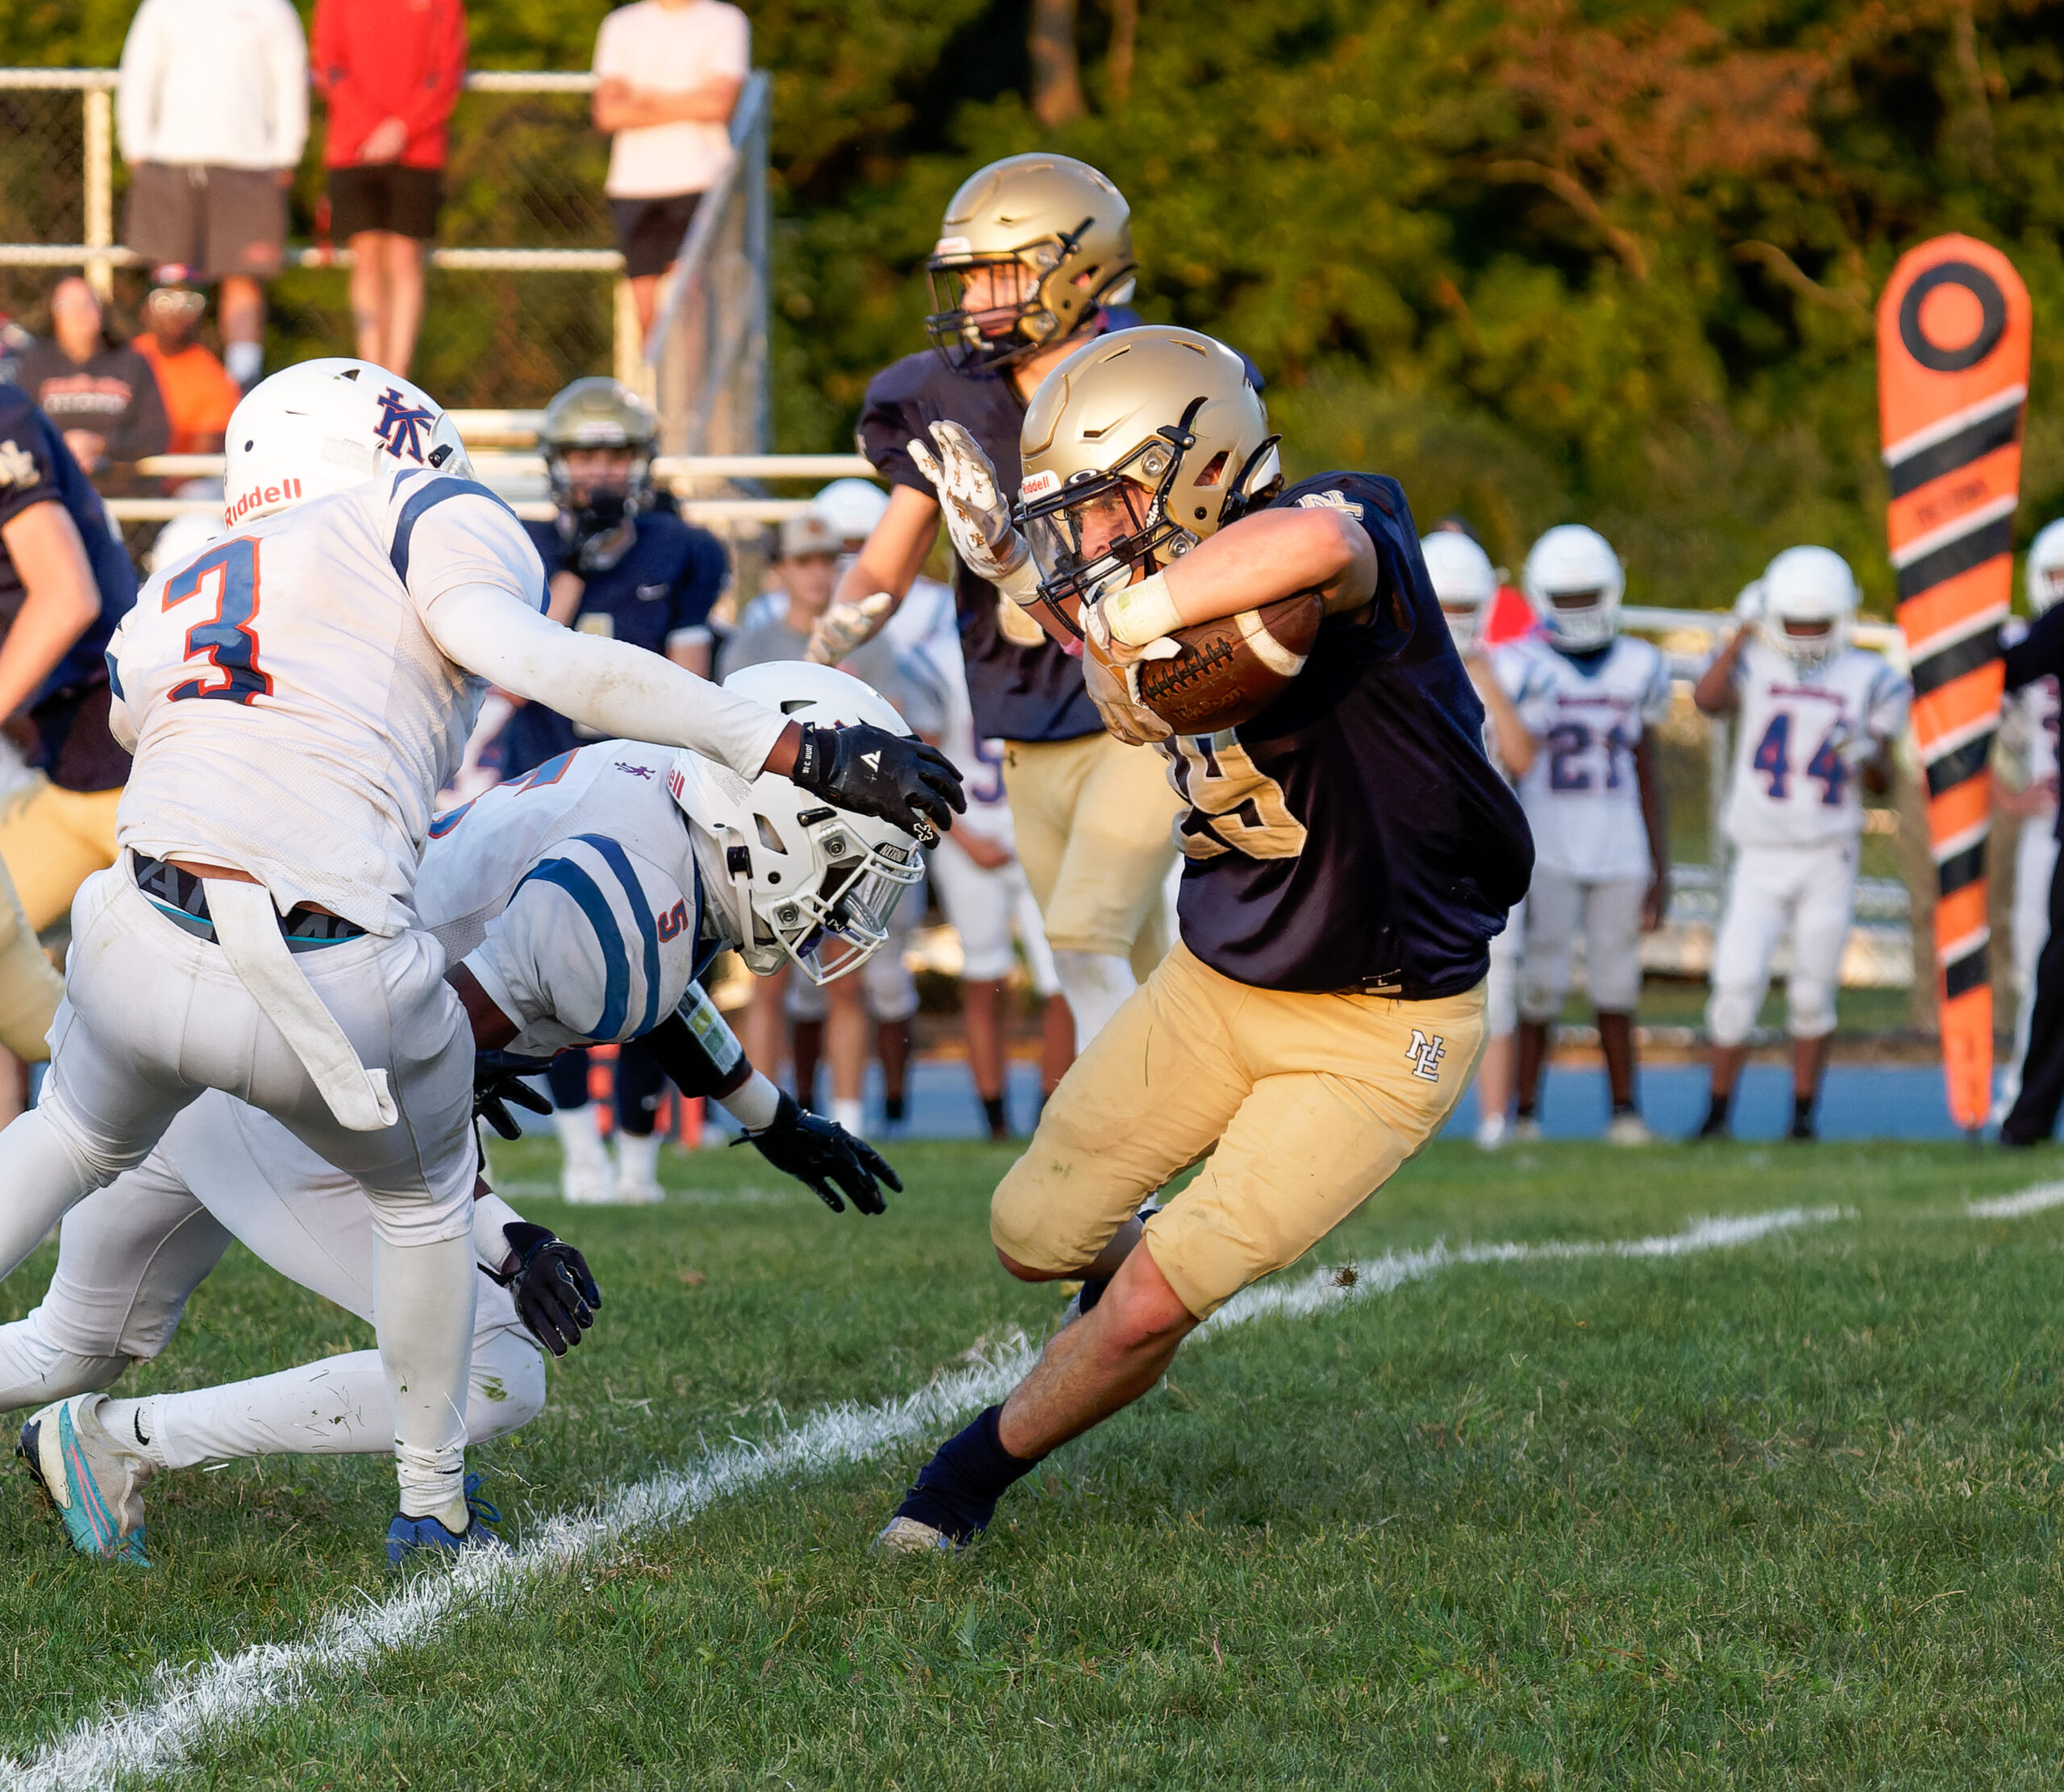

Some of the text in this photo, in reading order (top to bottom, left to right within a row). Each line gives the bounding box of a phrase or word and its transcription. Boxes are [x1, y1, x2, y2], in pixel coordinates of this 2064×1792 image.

[224, 477, 302, 530] Riddell
[1022, 476, 1051, 495] Riddell
[161, 535, 274, 707] 3
[1546, 722, 1625, 791] 21
[1754, 713, 1847, 805] 44
[656, 898, 689, 943] 5
[1404, 1029, 1446, 1083] NE
